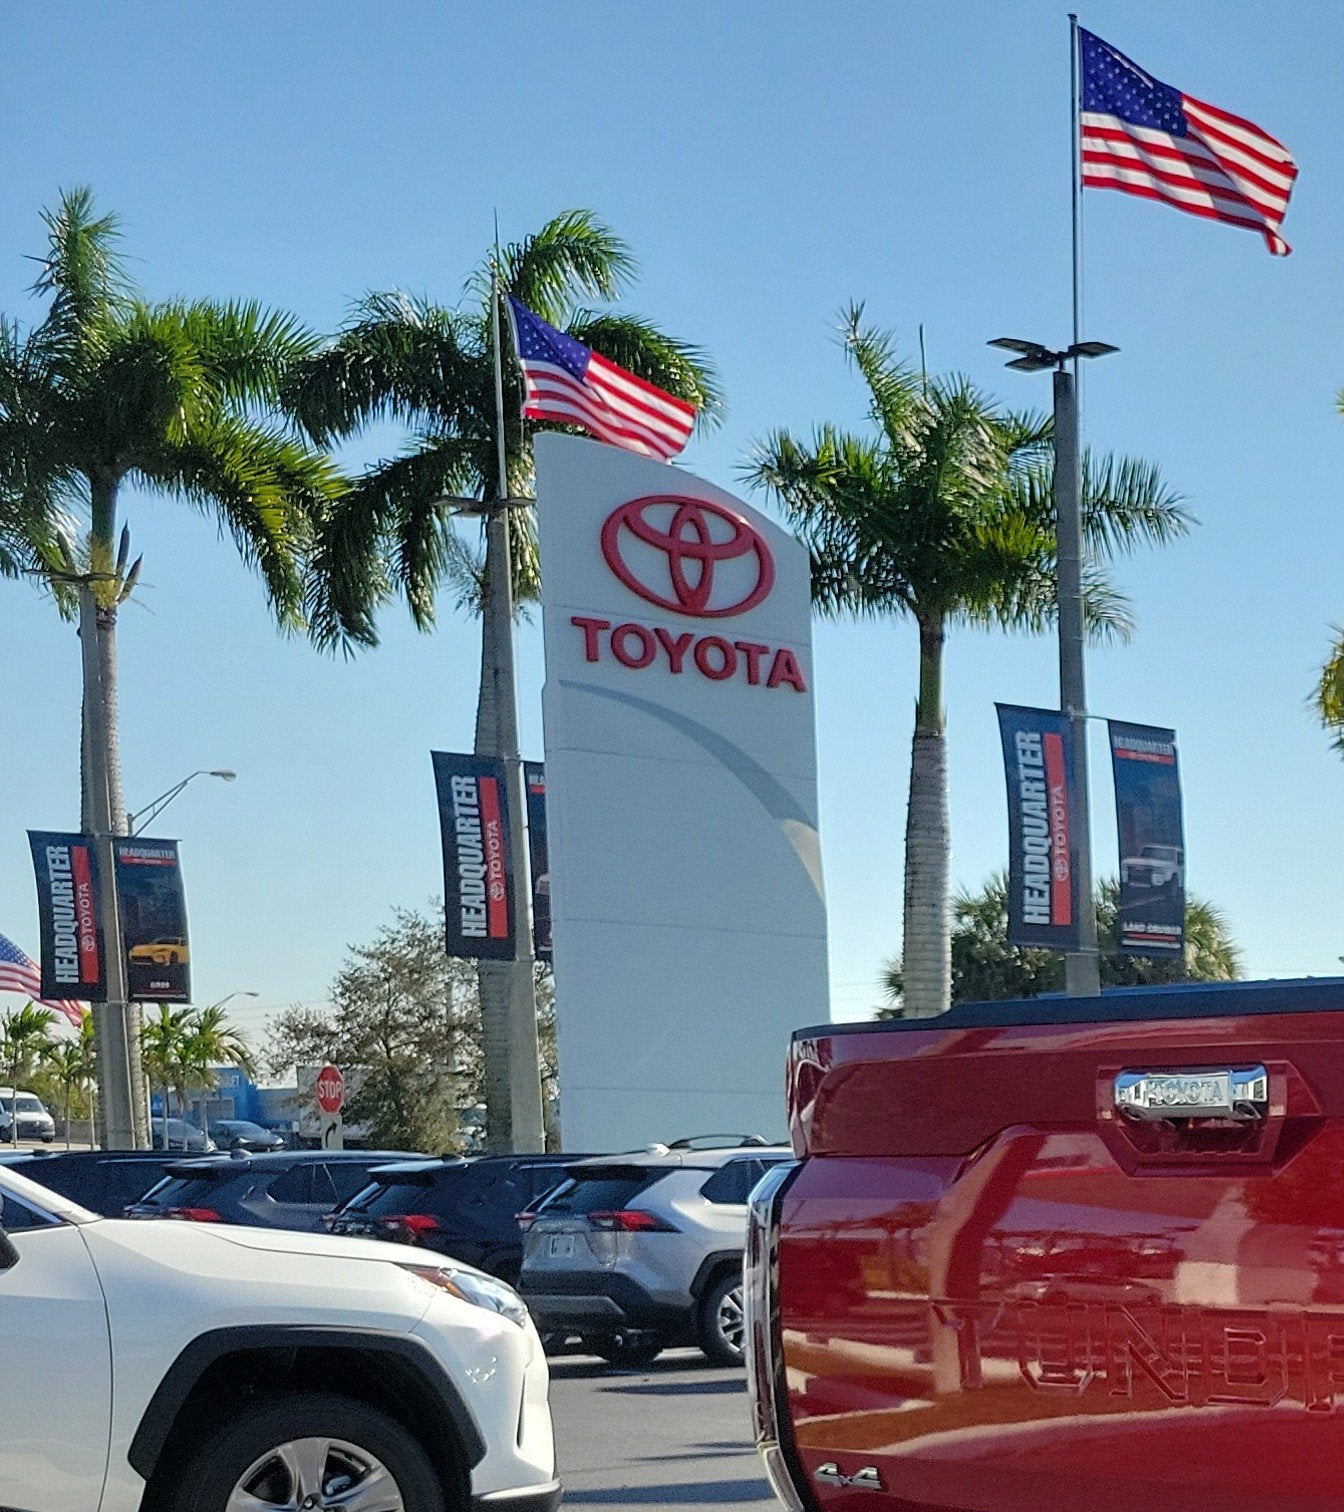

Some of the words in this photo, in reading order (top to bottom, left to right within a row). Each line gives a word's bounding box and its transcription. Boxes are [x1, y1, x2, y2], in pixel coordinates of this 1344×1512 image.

[571, 616, 807, 693] TOYOTA
[452, 775, 488, 938] HEADQUARTER
[487, 821, 502, 879] TOYOTA
[1015, 731, 1052, 925] HEADQUARTER
[1051, 785, 1068, 857] TOYOTA
[46, 846, 80, 984] HEADQUARTER
[77, 883, 95, 938] TOYOTA
[318, 1079, 342, 1099] STOP
[1150, 1078, 1223, 1104] TOYOTA
